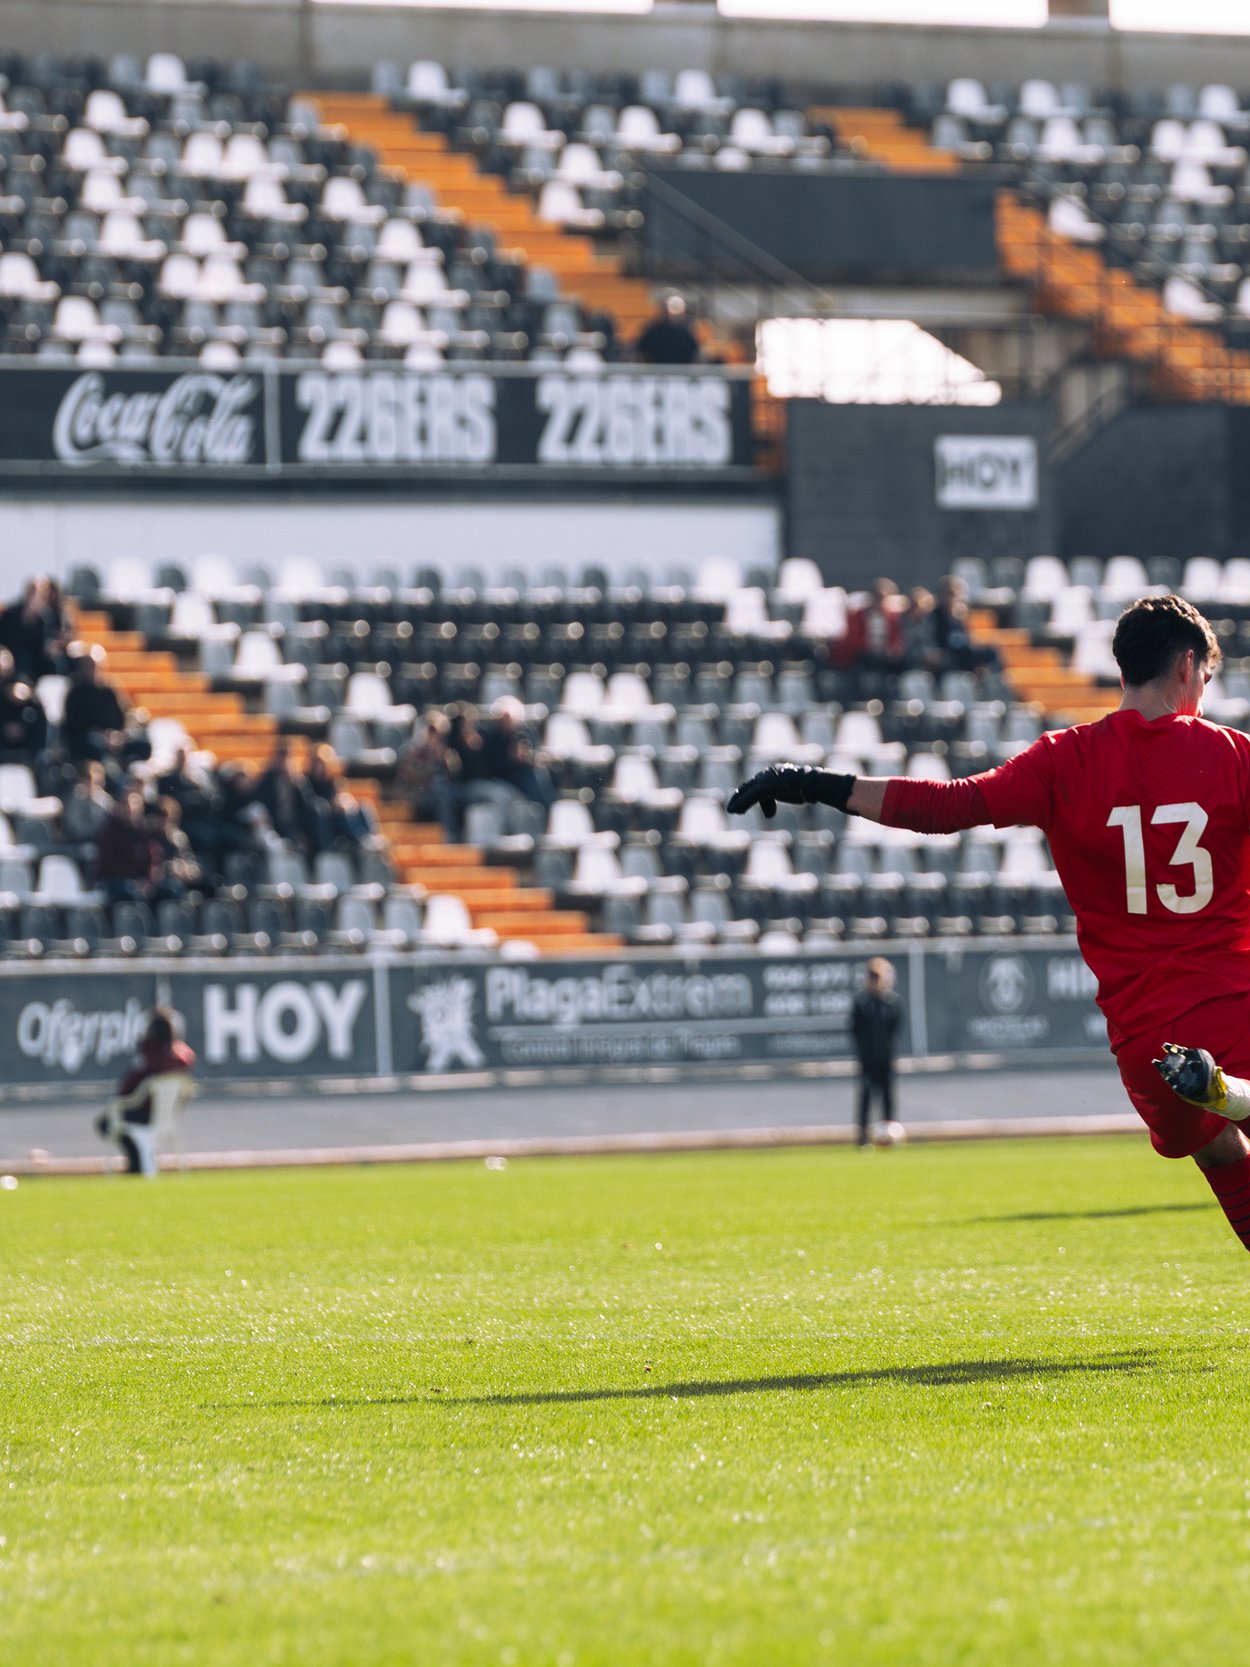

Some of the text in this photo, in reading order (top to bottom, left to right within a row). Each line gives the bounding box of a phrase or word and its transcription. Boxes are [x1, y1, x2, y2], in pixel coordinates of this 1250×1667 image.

[296, 372, 733, 466] 226ERS 226ERS
[938, 451, 1023, 493] HOY
[1105, 801, 1214, 915] 13
[204, 980, 367, 1063] HOY
